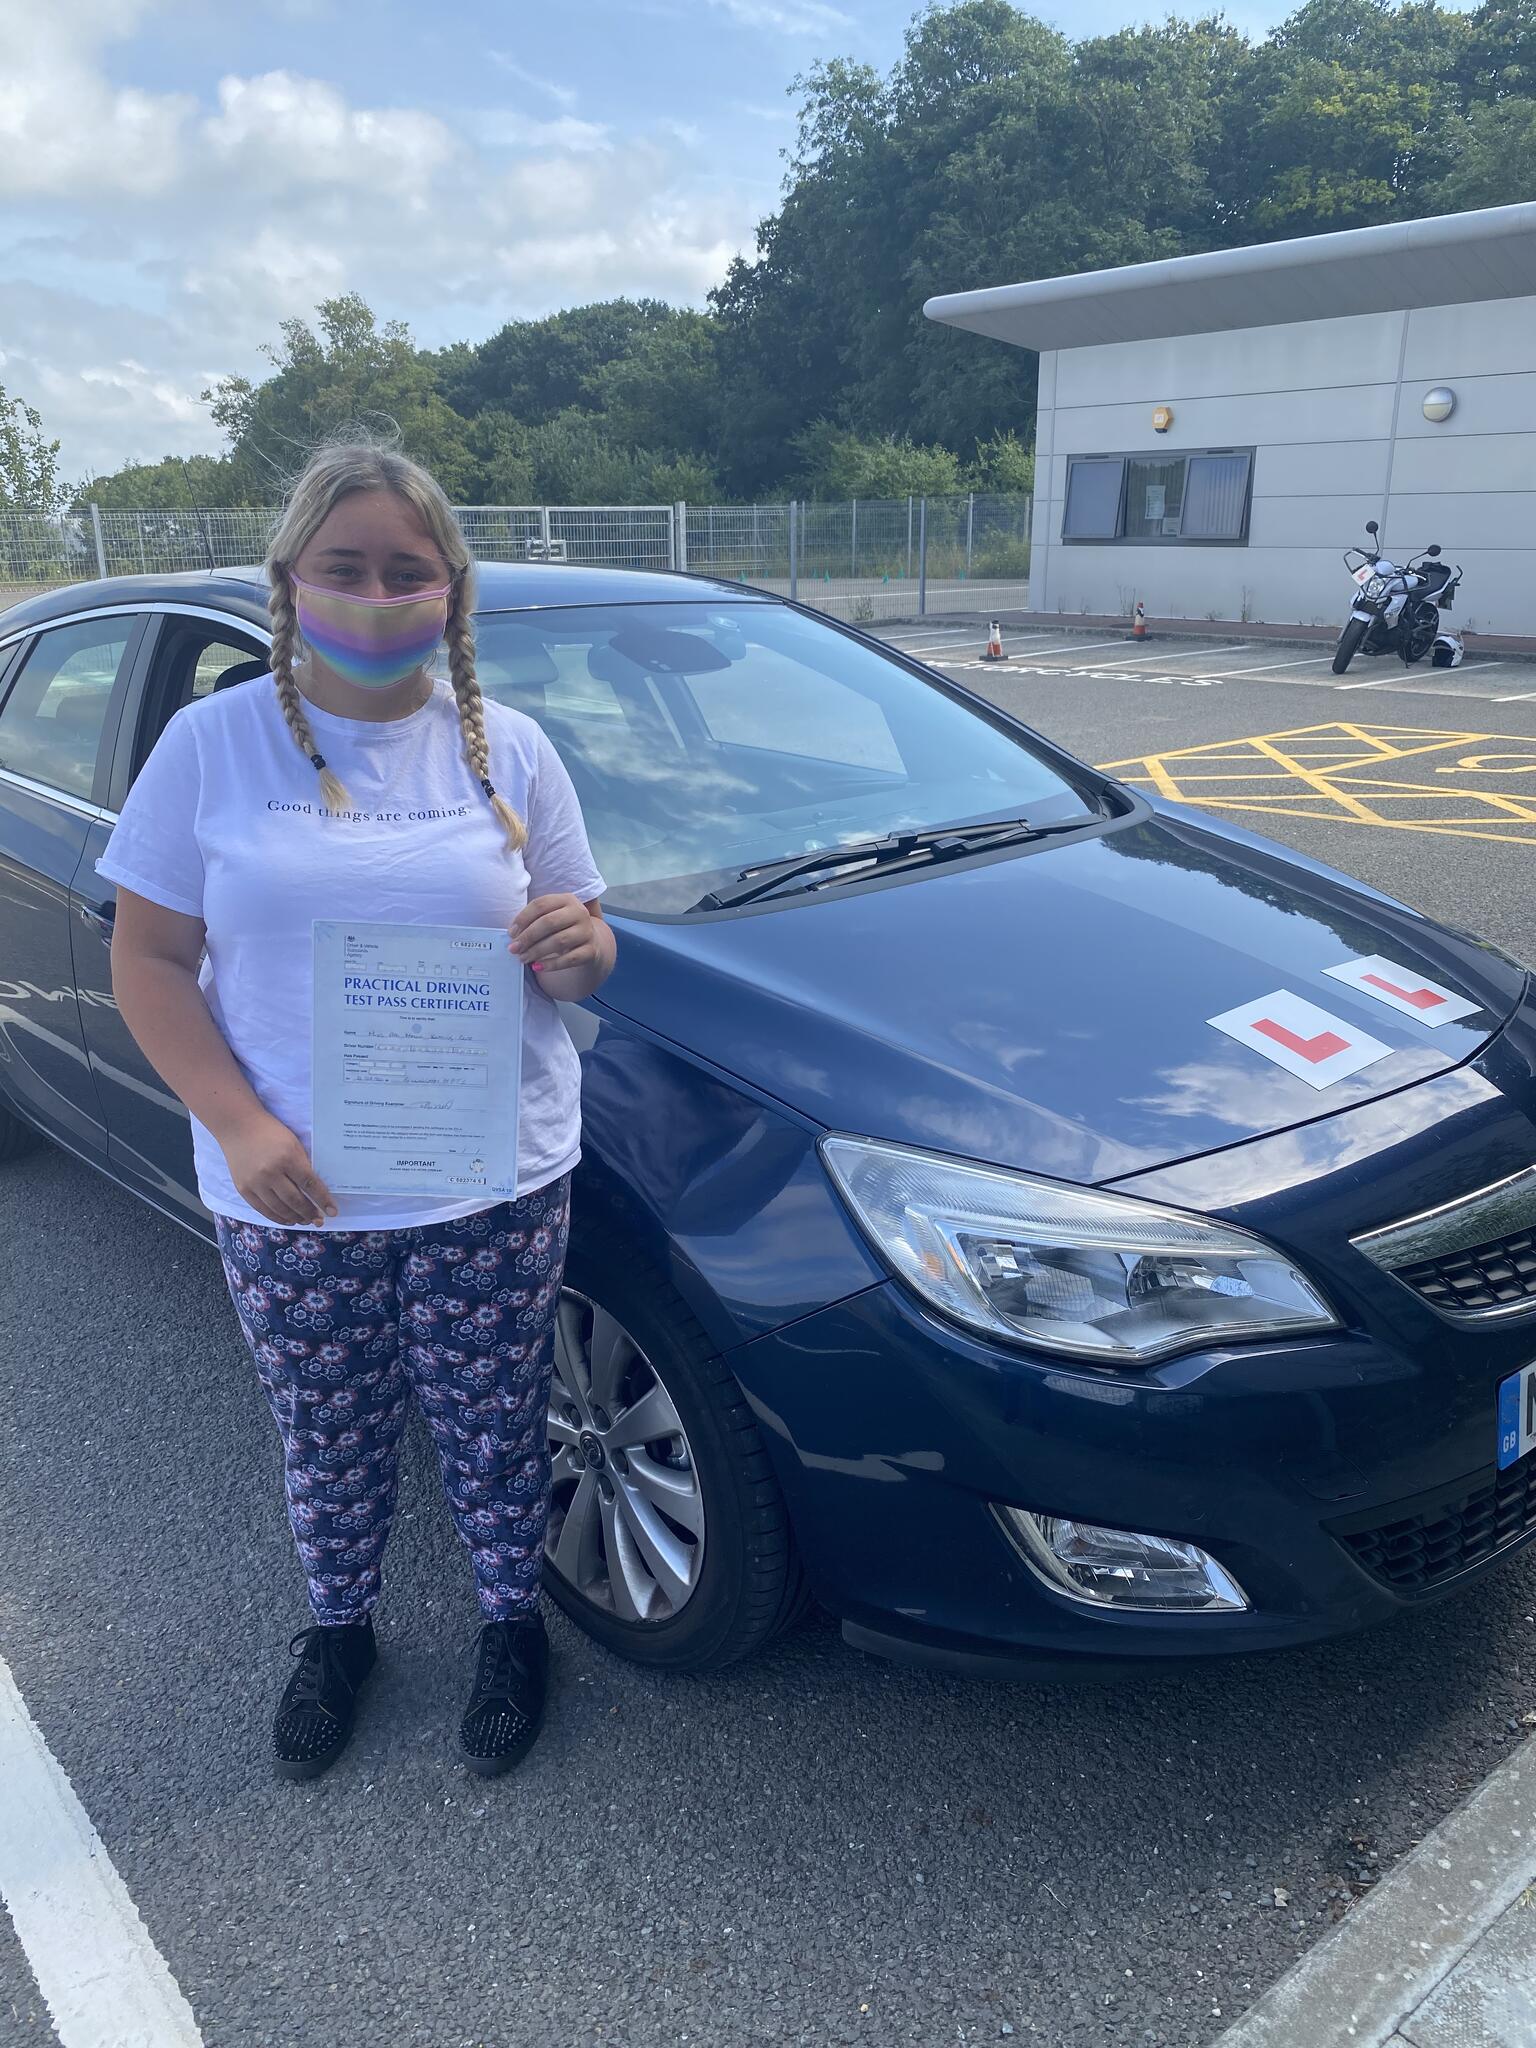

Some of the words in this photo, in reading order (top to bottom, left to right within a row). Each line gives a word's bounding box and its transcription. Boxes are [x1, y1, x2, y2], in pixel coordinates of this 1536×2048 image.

[267, 800, 312, 815] Good
[318, 807, 370, 823] things
[376, 811, 401, 822] are
[344, 977, 421, 993] PRACTICAL
[426, 981, 490, 996] DRIVING
[1359, 973, 1449, 1010] L
[344, 994, 373, 1006] TEST
[377, 995, 407, 1008] PASS
[411, 997, 490, 1012] CERTIFICATE
[1249, 1017, 1353, 1065] L
[1502, 1430, 1517, 1453] GB
